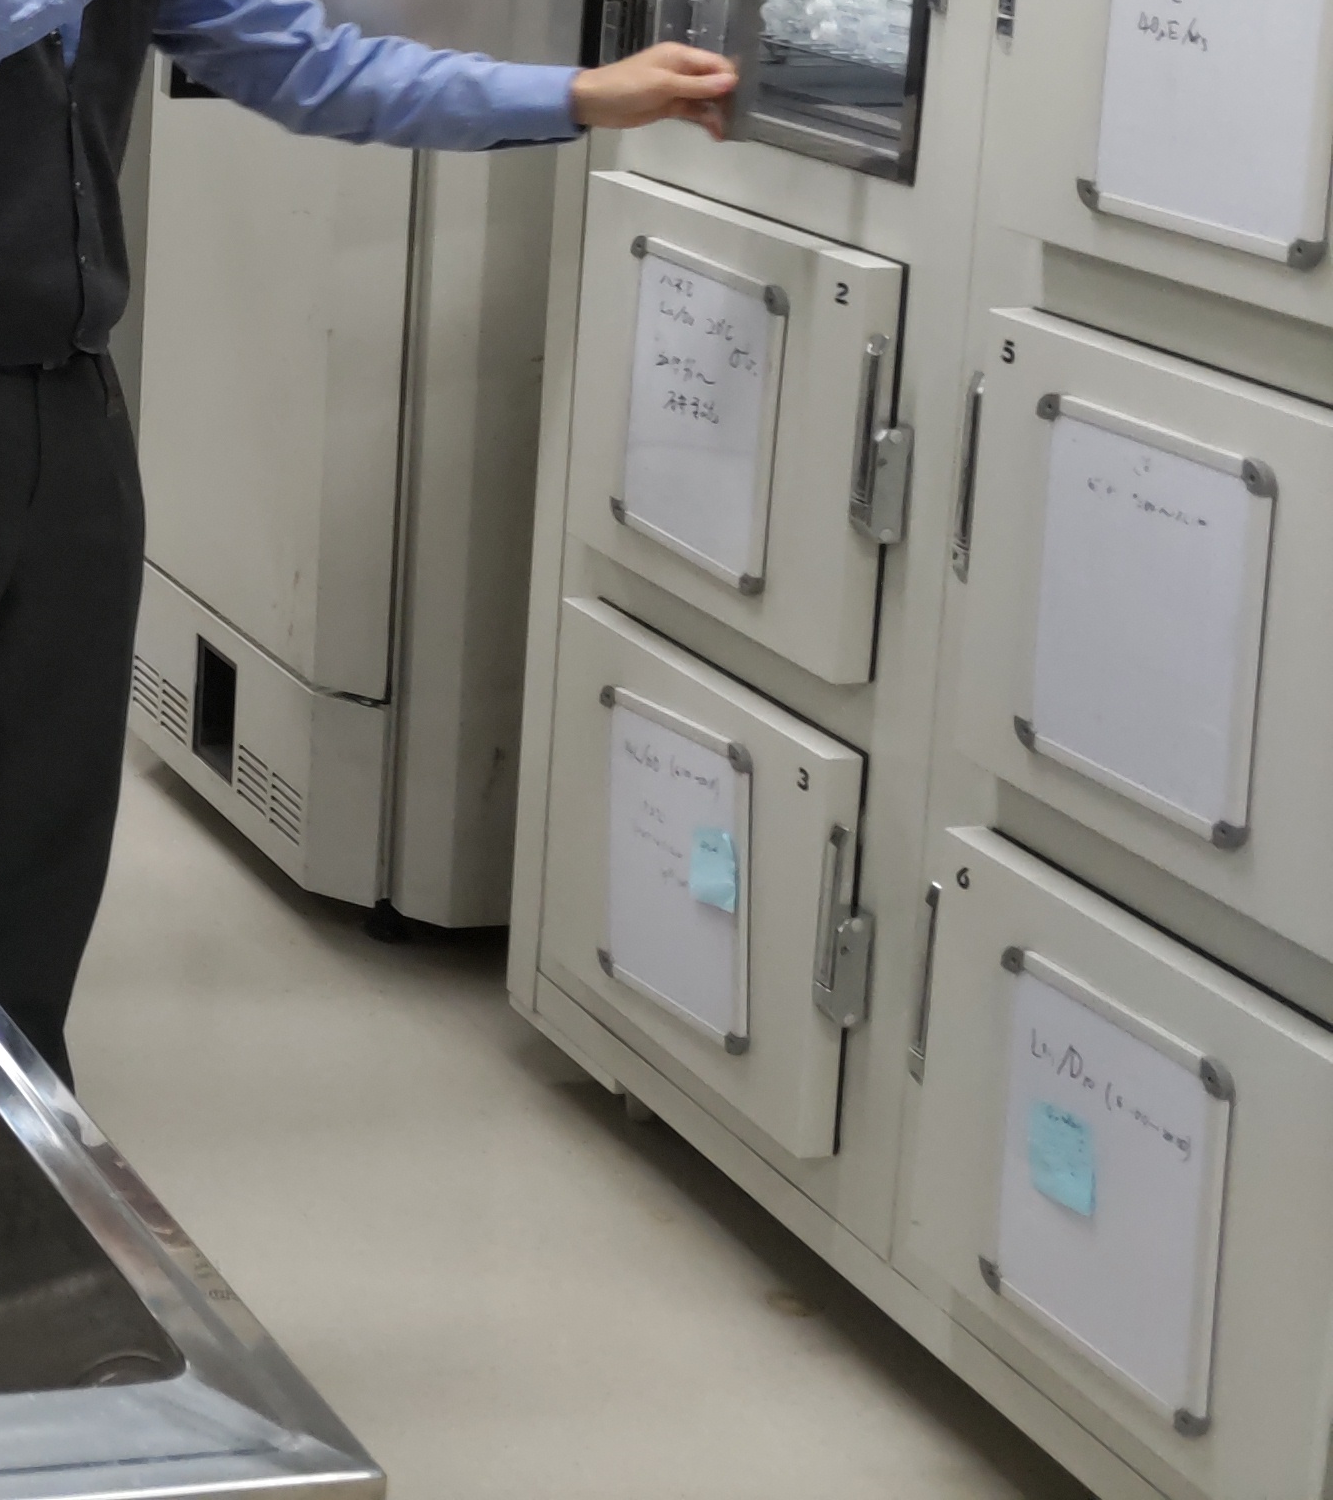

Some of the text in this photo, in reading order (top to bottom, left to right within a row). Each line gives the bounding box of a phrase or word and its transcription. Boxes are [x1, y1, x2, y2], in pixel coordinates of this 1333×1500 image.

[833, 281, 850, 306] 2
[1000, 340, 1017, 364] 5
[796, 766, 810, 792] 3
[956, 866, 971, 891] 6
